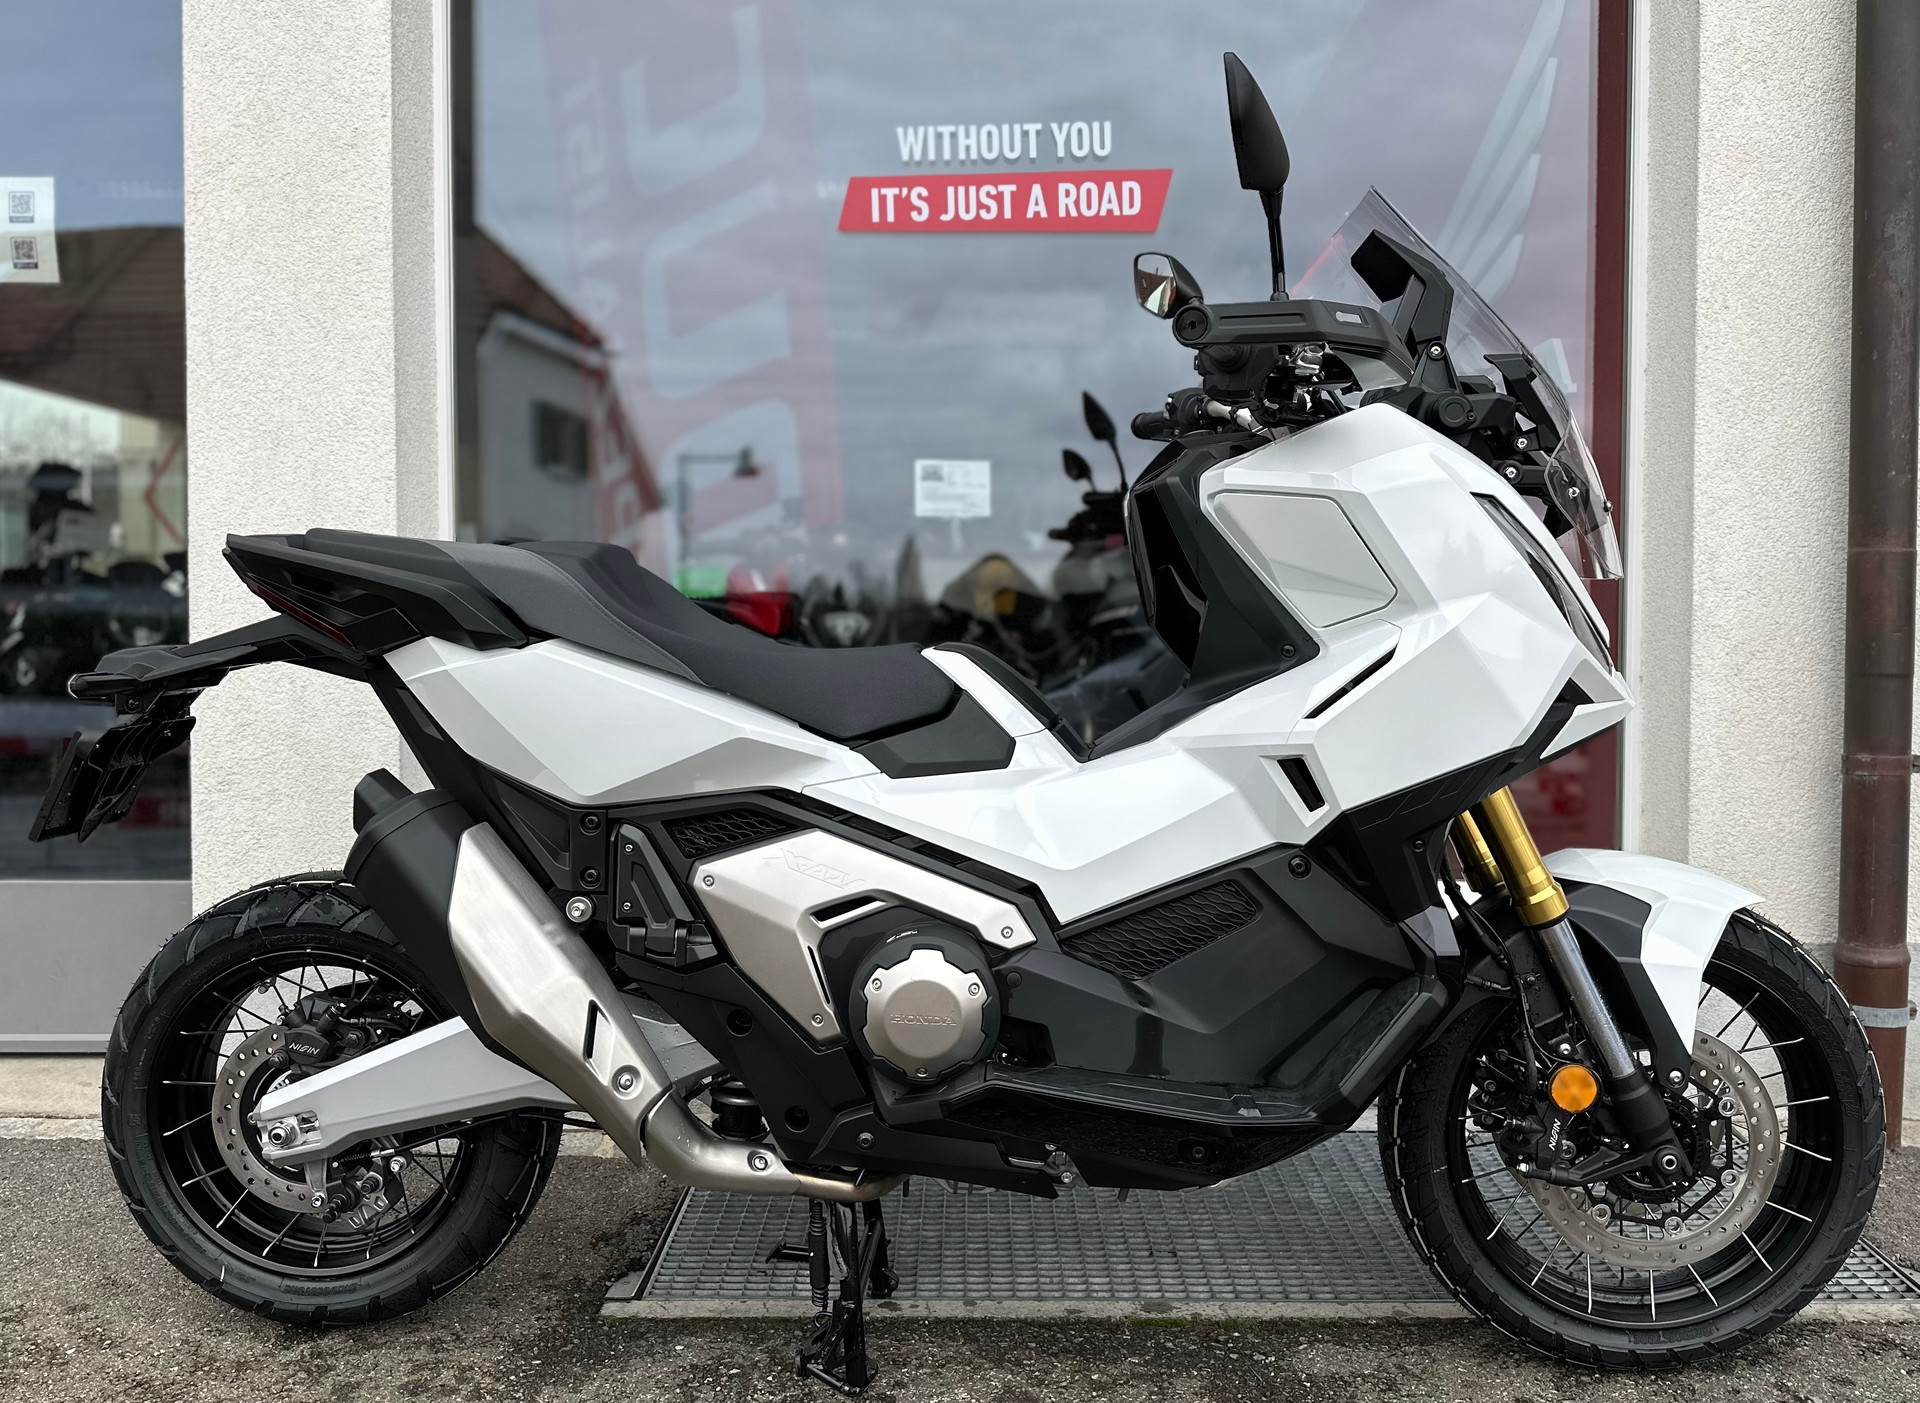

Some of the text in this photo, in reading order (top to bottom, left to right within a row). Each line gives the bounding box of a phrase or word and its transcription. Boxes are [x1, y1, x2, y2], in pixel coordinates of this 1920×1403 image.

[896, 121, 1112, 162] WITHOUT YOU
[871, 187, 929, 222] IT'S
[939, 184, 1017, 221] JUST
[1026, 183, 1048, 218] A
[1058, 181, 1142, 217] ROAD
[890, 1013, 957, 1026] HONDA
